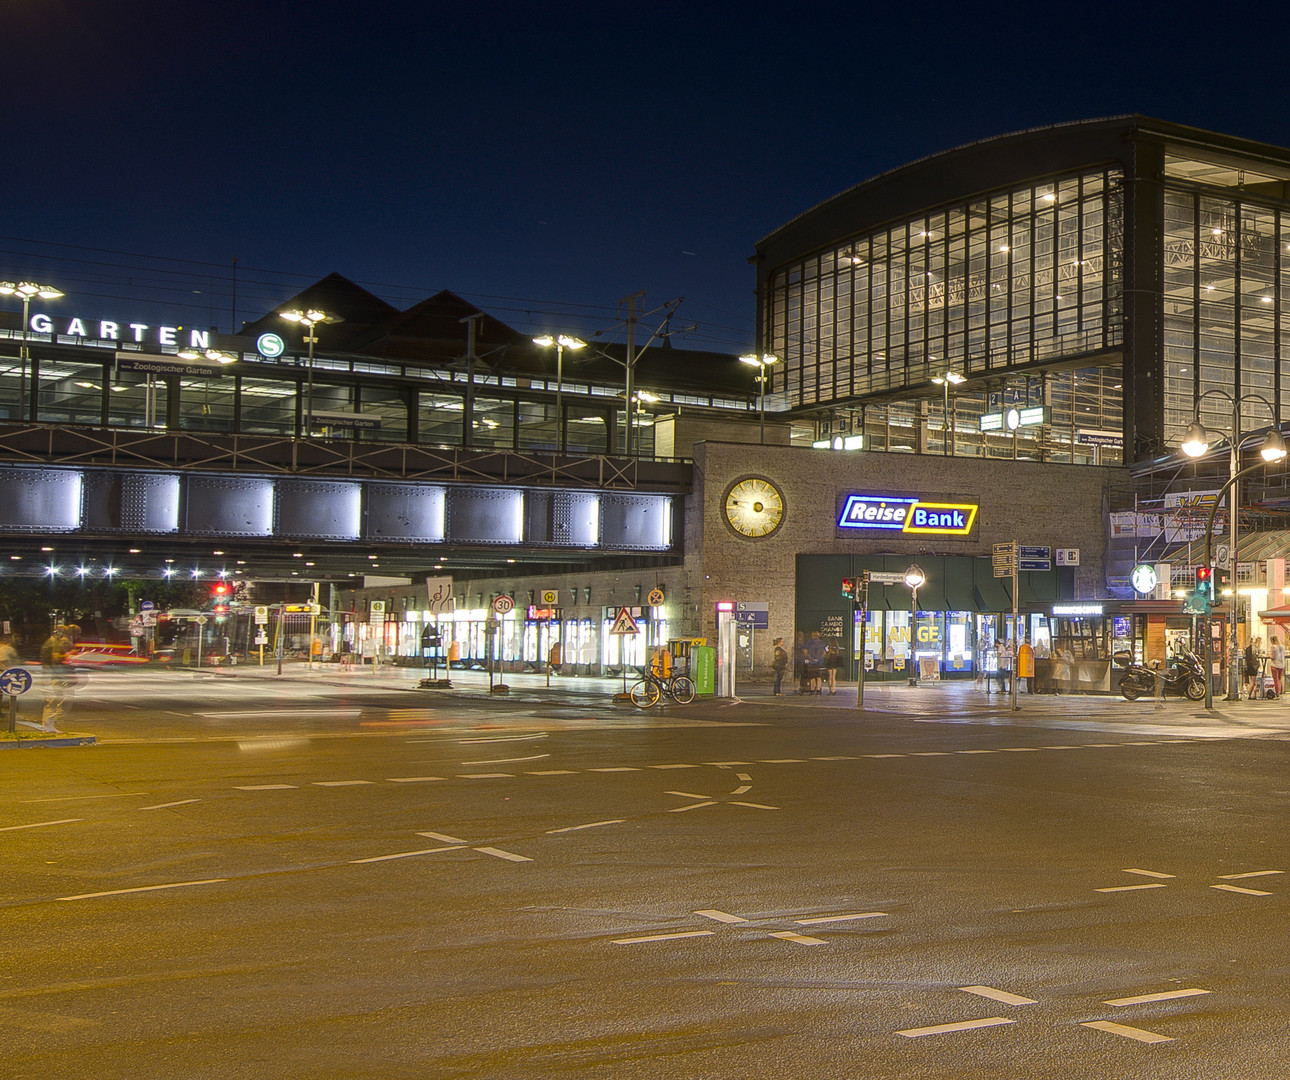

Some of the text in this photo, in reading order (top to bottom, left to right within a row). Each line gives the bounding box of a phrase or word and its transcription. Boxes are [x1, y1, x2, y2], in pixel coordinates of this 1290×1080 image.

[30, 314, 209, 349] GARTEN
[261, 336, 280, 355] S
[133, 362, 184, 374] Zoologischer
[186, 366, 212, 376] Garten
[1014, 390, 1019, 400] A
[316, 417, 374, 428] Zoologischer Garten
[850, 502, 906, 521] Reise
[914, 509, 964, 527] Bank
[497, 600, 510, 610] 30
